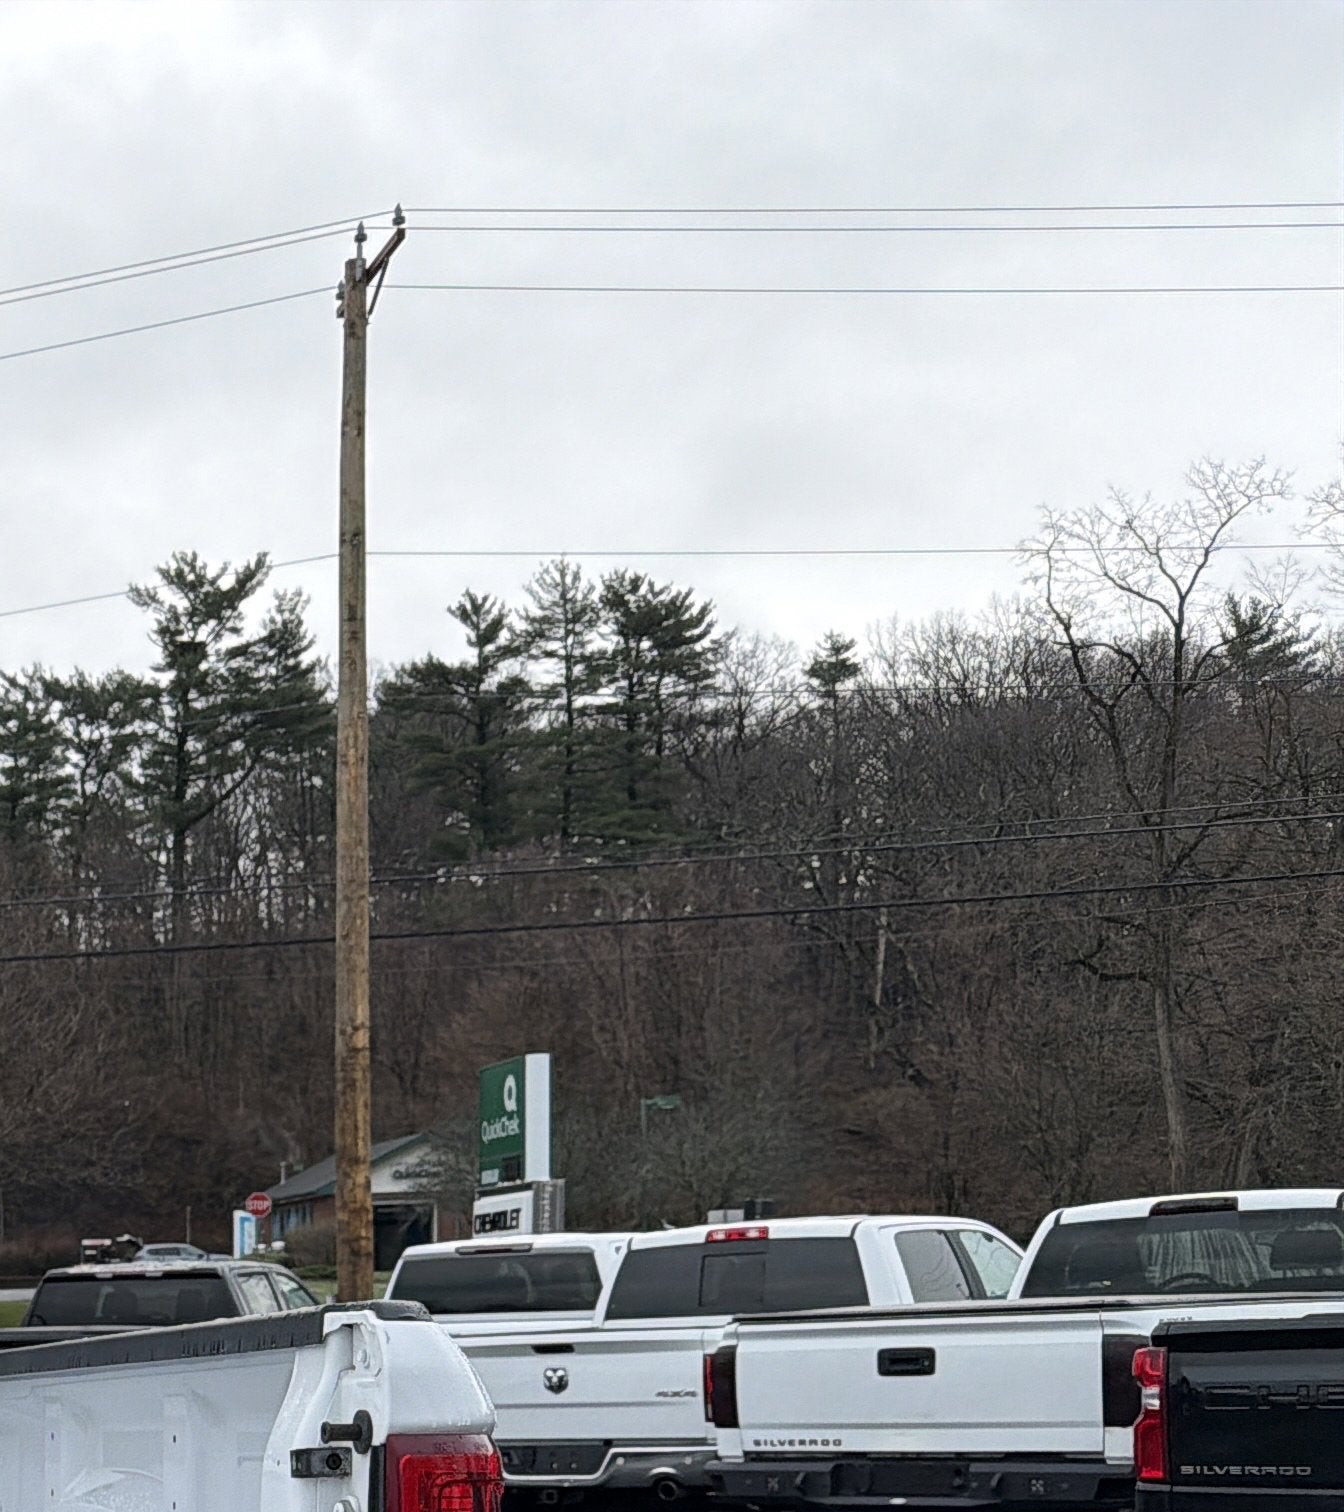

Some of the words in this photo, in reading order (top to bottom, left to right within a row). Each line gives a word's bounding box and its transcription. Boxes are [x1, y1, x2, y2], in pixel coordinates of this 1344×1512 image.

[503, 1073, 517, 1112] Q
[481, 1113, 520, 1144] QuickChek
[246, 1200, 271, 1211] STOP
[752, 1438, 843, 1448] SILVERADO
[1179, 1464, 1312, 1477] SILVERADO
